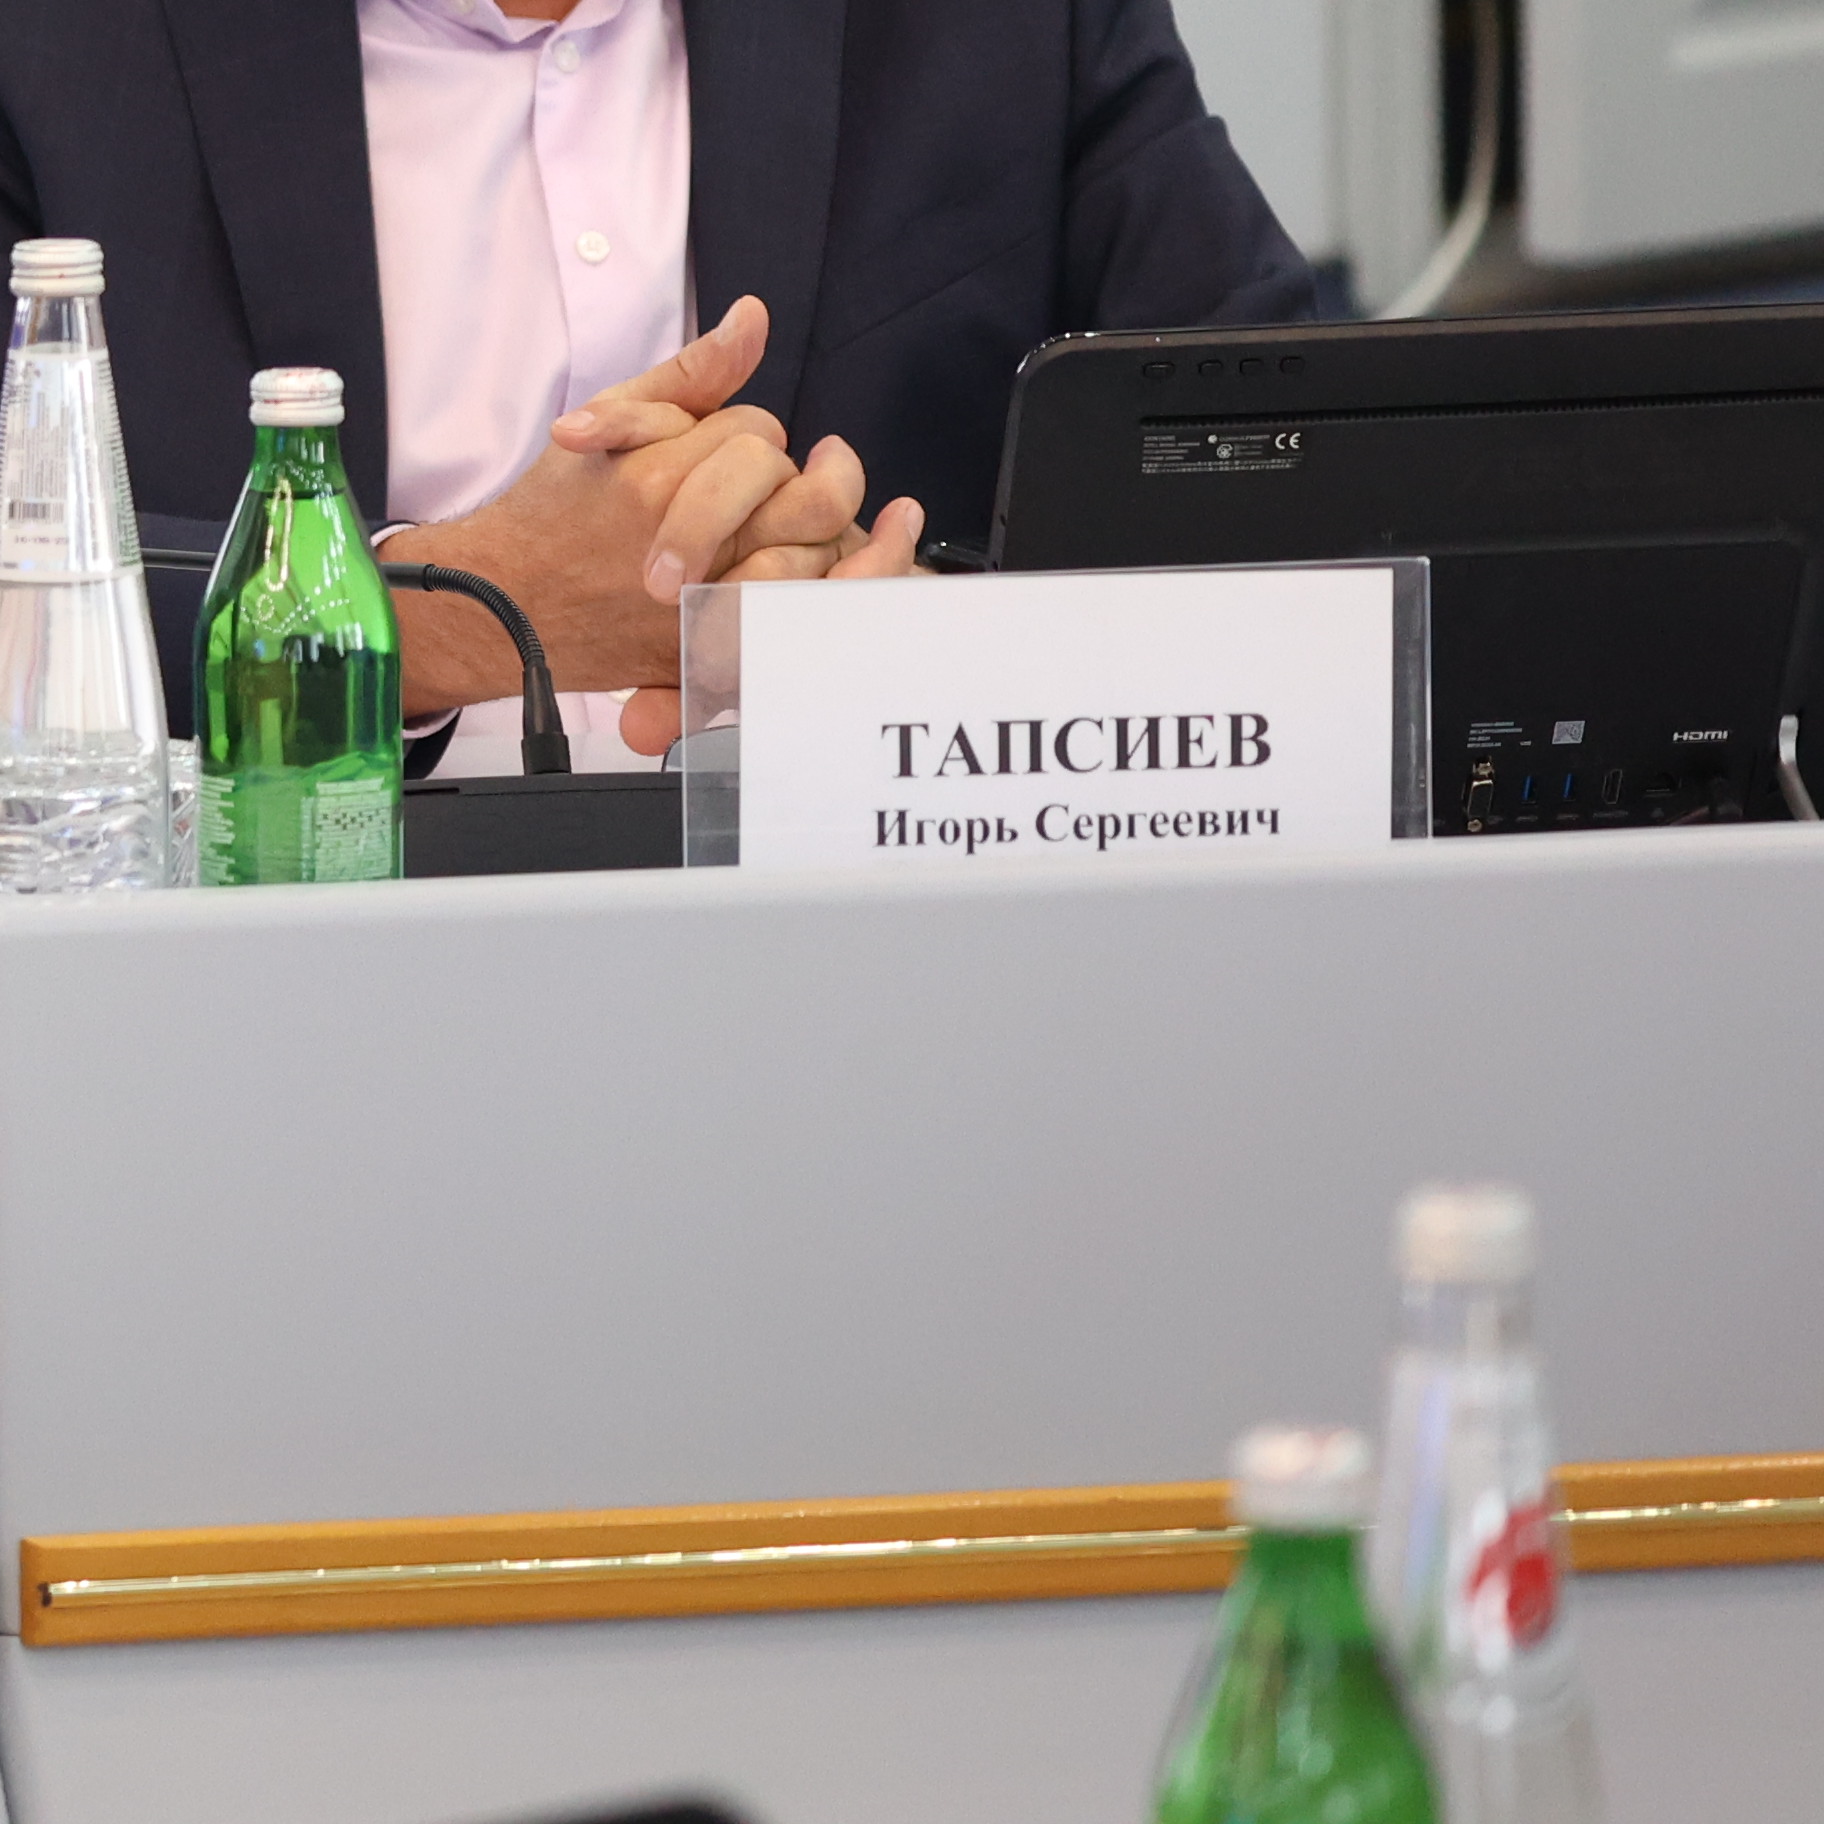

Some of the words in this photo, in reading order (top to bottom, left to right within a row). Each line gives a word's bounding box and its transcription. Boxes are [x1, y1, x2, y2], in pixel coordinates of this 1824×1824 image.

[881, 713, 1272, 778] ТАПСИЕВ
[873, 809, 1019, 855] Игорь
[1034, 803, 1281, 852] Сергеевич
